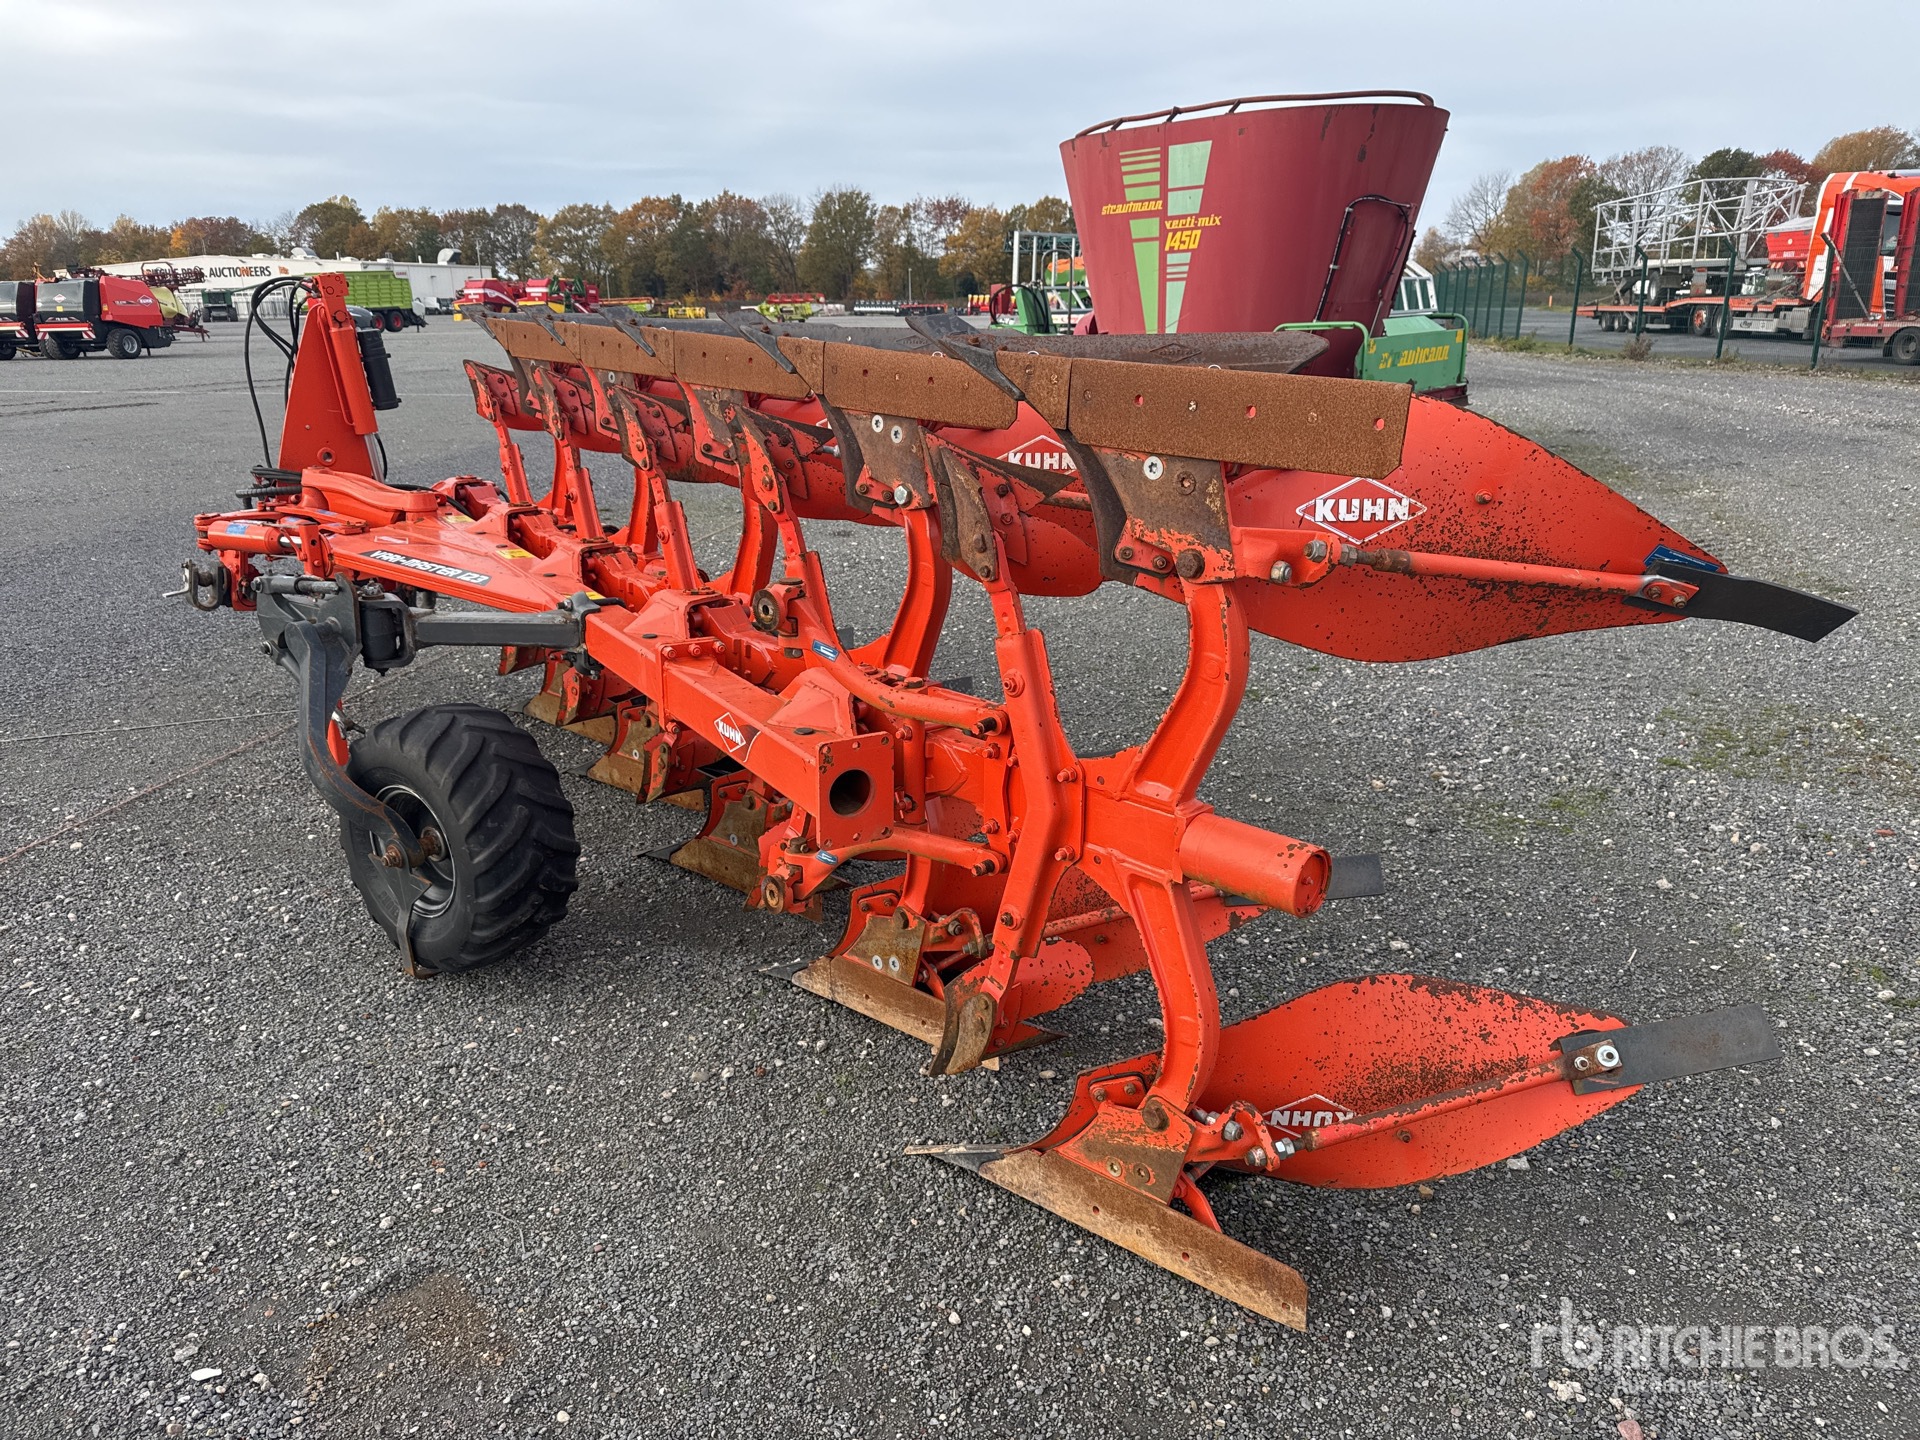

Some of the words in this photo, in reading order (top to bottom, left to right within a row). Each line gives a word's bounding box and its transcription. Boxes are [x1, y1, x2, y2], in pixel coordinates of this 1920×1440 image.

[1164, 229, 1202, 252] 1450
[209, 265, 271, 278] AUCTIONEERS
[1314, 497, 1410, 522] KUHN
[369, 549, 463, 578] VARI-MASTER
[456, 569, 490, 583] 123
[718, 718, 742, 746] KUHN
